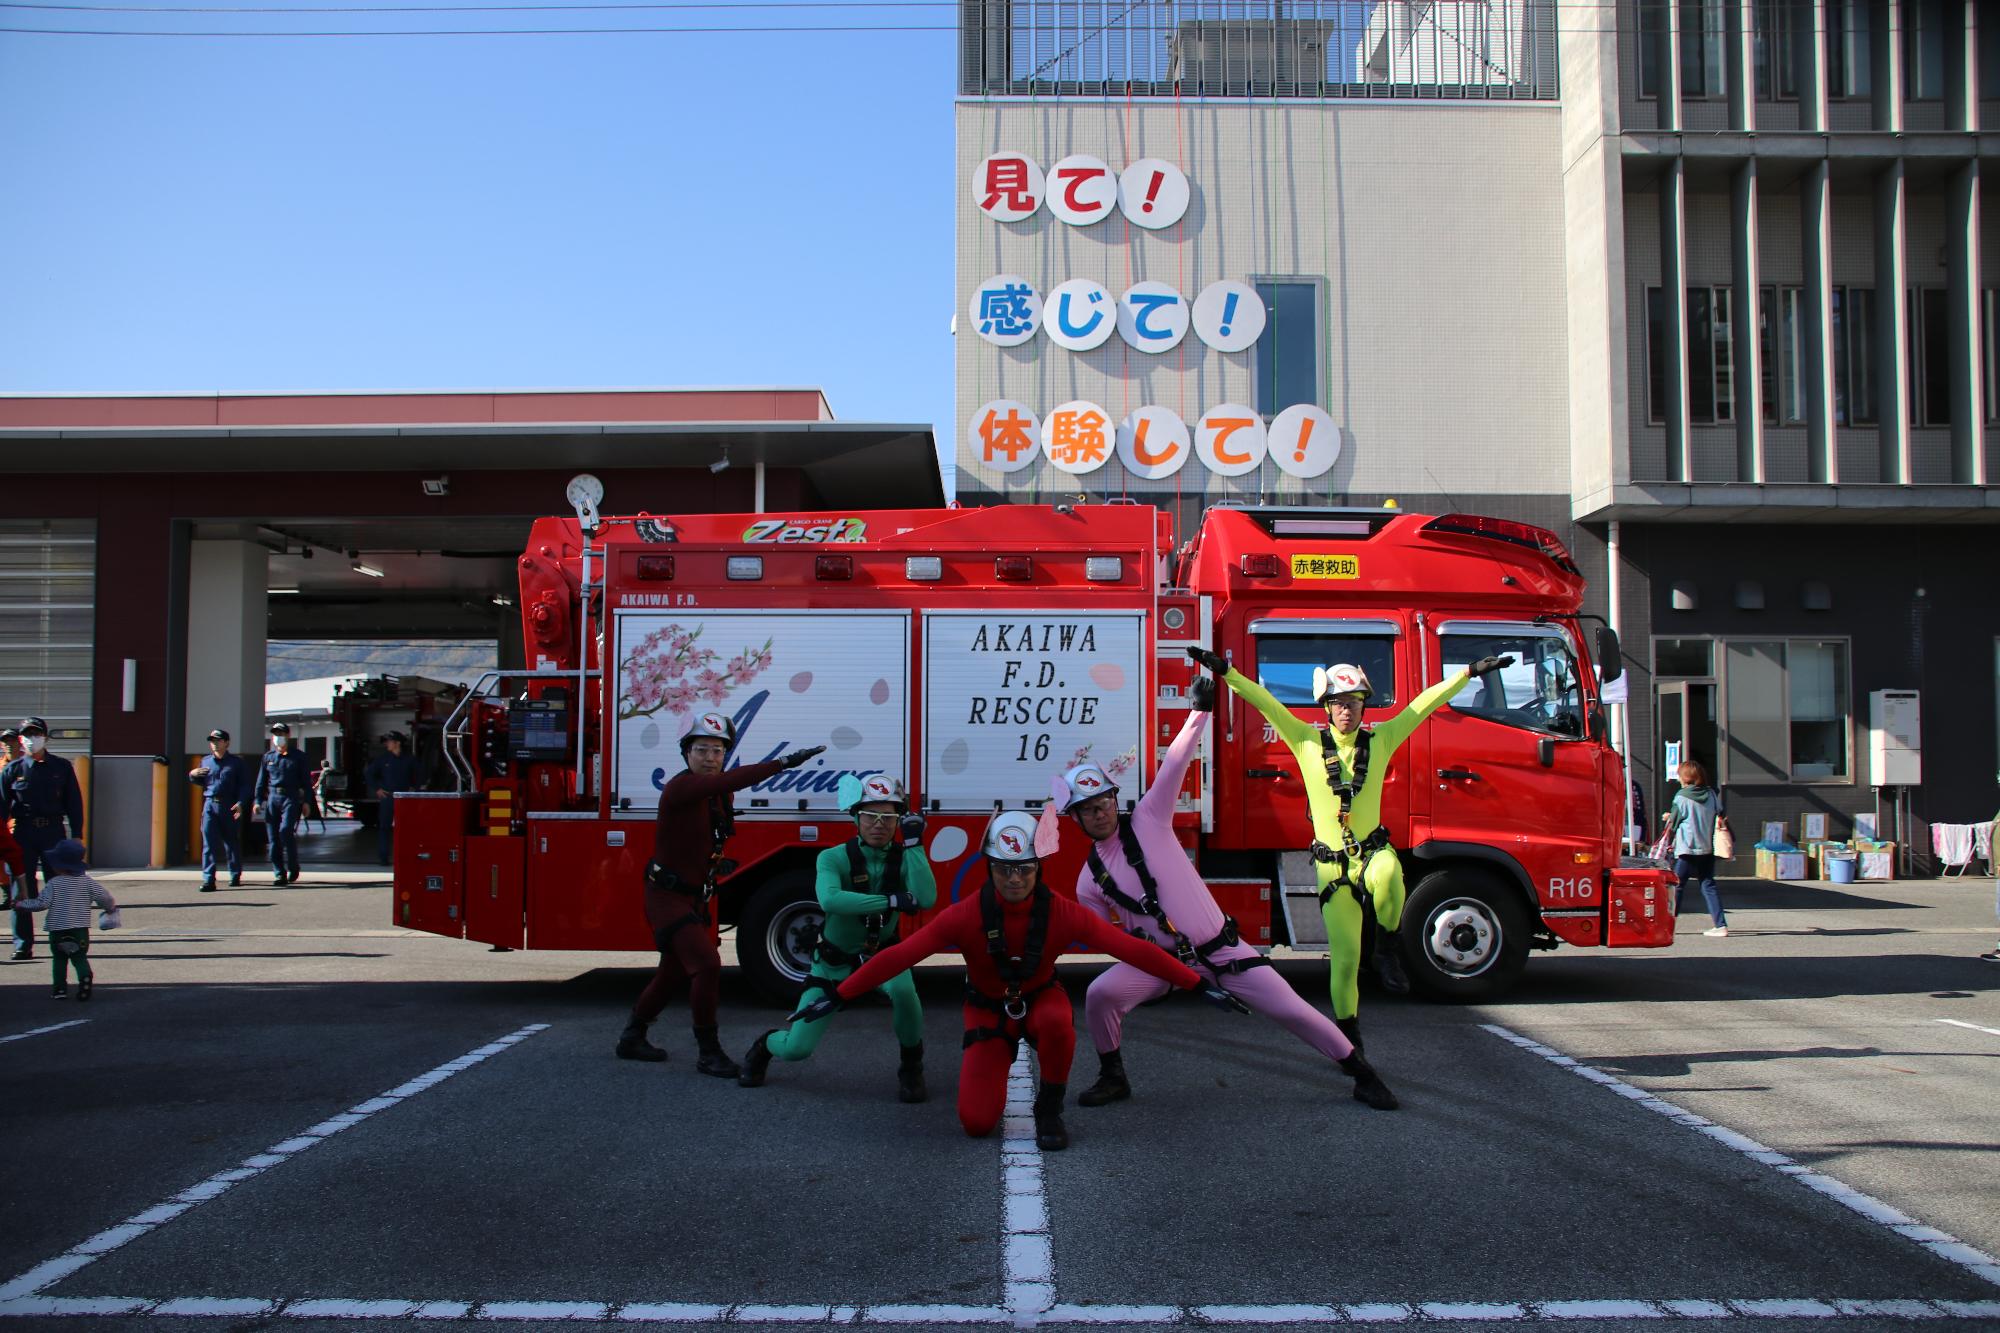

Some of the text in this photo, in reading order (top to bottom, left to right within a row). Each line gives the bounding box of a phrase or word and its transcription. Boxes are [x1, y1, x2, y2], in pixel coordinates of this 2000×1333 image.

[980, 158, 1165, 213] 見て！
[979, 284, 1239, 339] 感じて！
[978, 409, 1315, 466] 体験して！
[744, 519, 847, 543] Zest
[1294, 559, 1356, 575] 赤磐救助
[620, 593, 699, 606] AKAIWA F.D.
[970, 624, 1097, 652] AKAIWA
[1001, 660, 1065, 688] F.D.
[967, 697, 1099, 725] RESCUE
[1016, 733, 1050, 762] 16
[1549, 877, 1593, 898] R16
